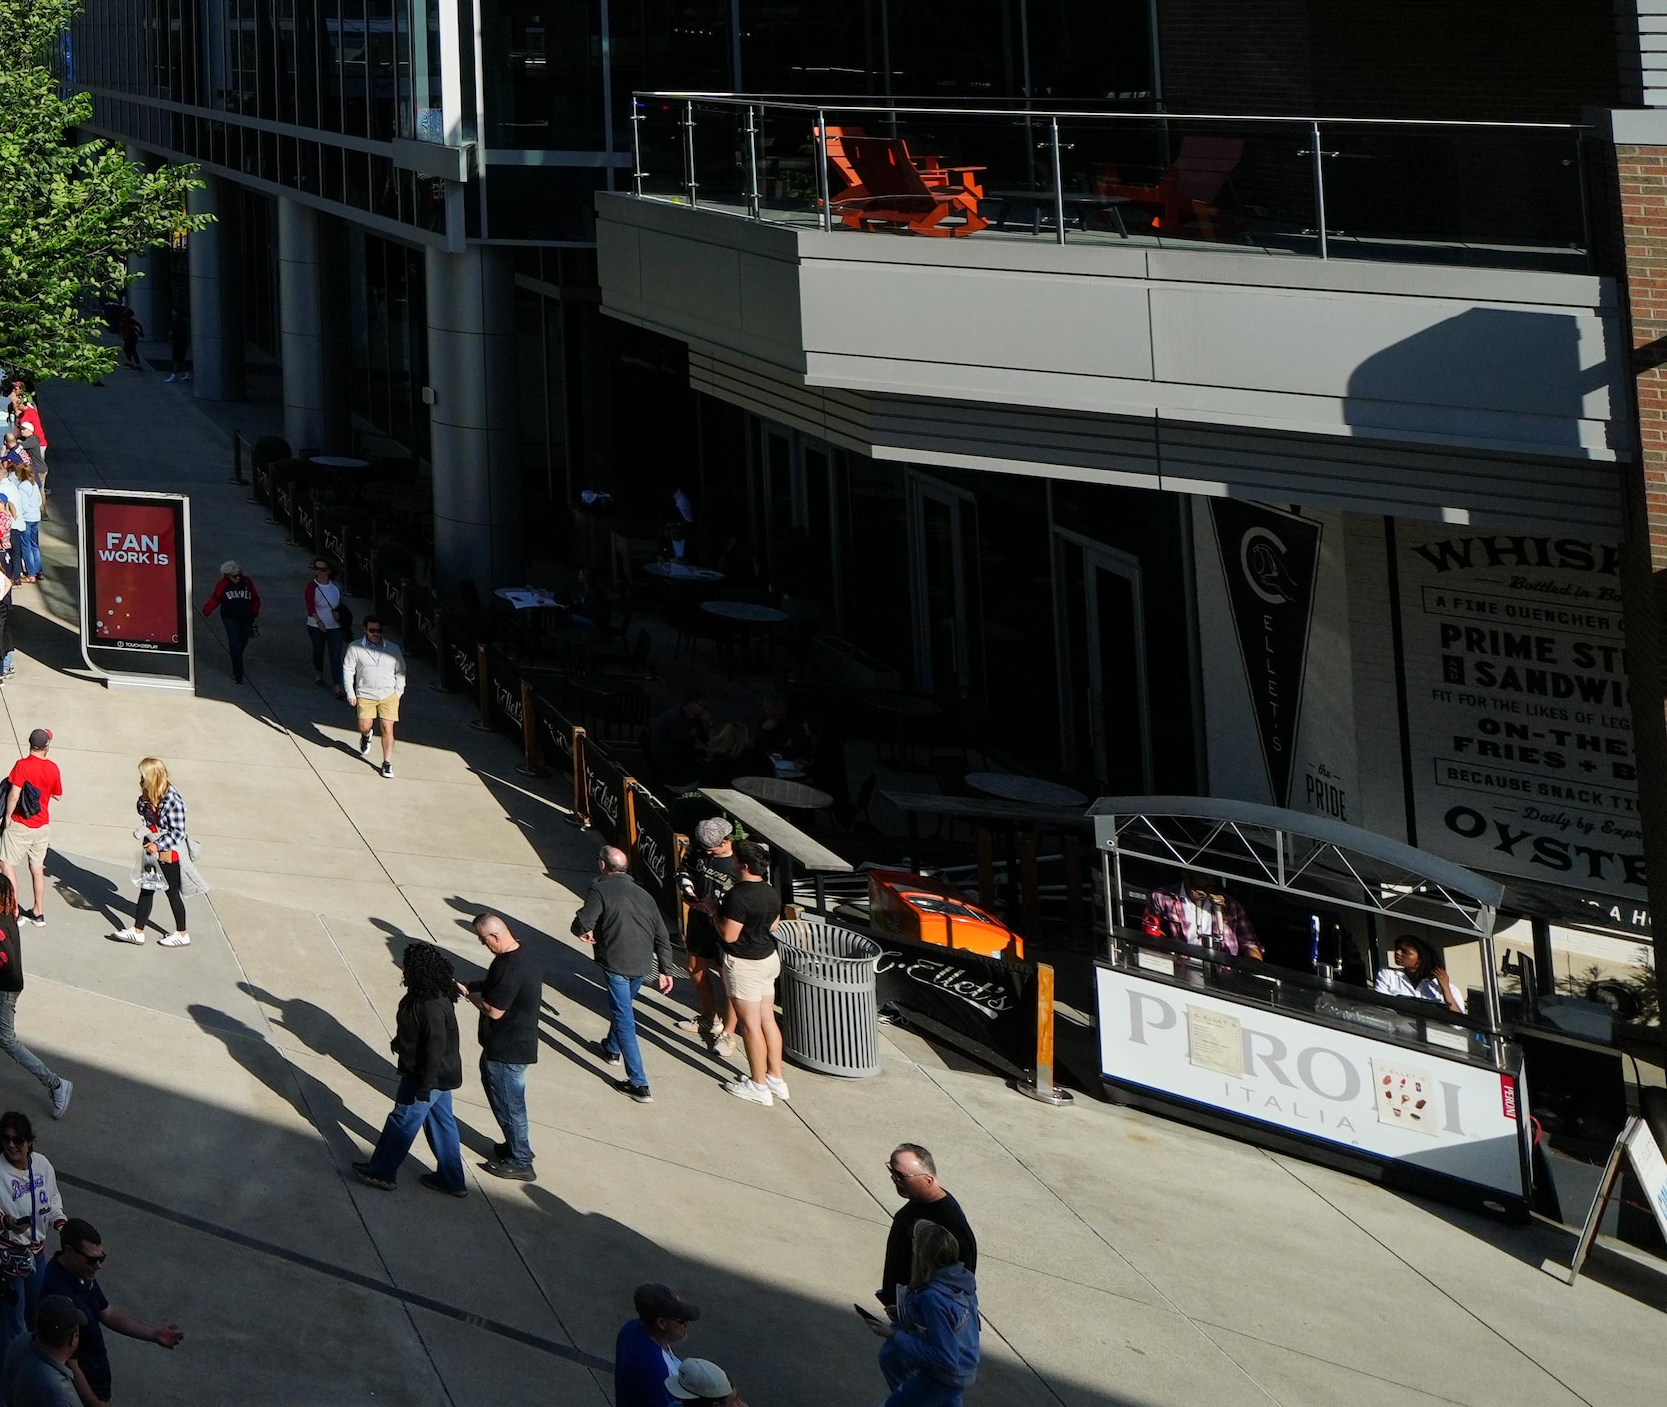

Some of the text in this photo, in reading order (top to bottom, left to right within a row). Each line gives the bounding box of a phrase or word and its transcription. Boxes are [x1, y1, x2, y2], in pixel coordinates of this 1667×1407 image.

[99, 550, 169, 565] WORK IS
[106, 532, 159, 553] FAN
[1509, 576, 1573, 596] Bottled
[1574, 586, 1592, 598] in
[1436, 596, 1610, 630] A FINE QUENCHER
[1440, 622, 1558, 664] PRIME
[1432, 689, 1453, 703] FIT
[1458, 694, 1488, 708] FOR
[1492, 697, 1520, 714] THE
[1525, 703, 1569, 723] LIKES
[1574, 710, 1596, 725] OF
[1453, 735, 1566, 770] FRIES
[1318, 763, 1332, 779] the
[1447, 767, 1532, 793] BECAUSE
[1538, 782, 1604, 806] SNACK
[1306, 773, 1347, 822] PRIDE
[1522, 806, 1573, 831] Daily
[1576, 815, 1595, 836] by
[1609, 905, 1652, 927] A H
[1224, 1081, 1356, 1134] ITALIA
[1503, 1084, 1515, 1119] PERONI
